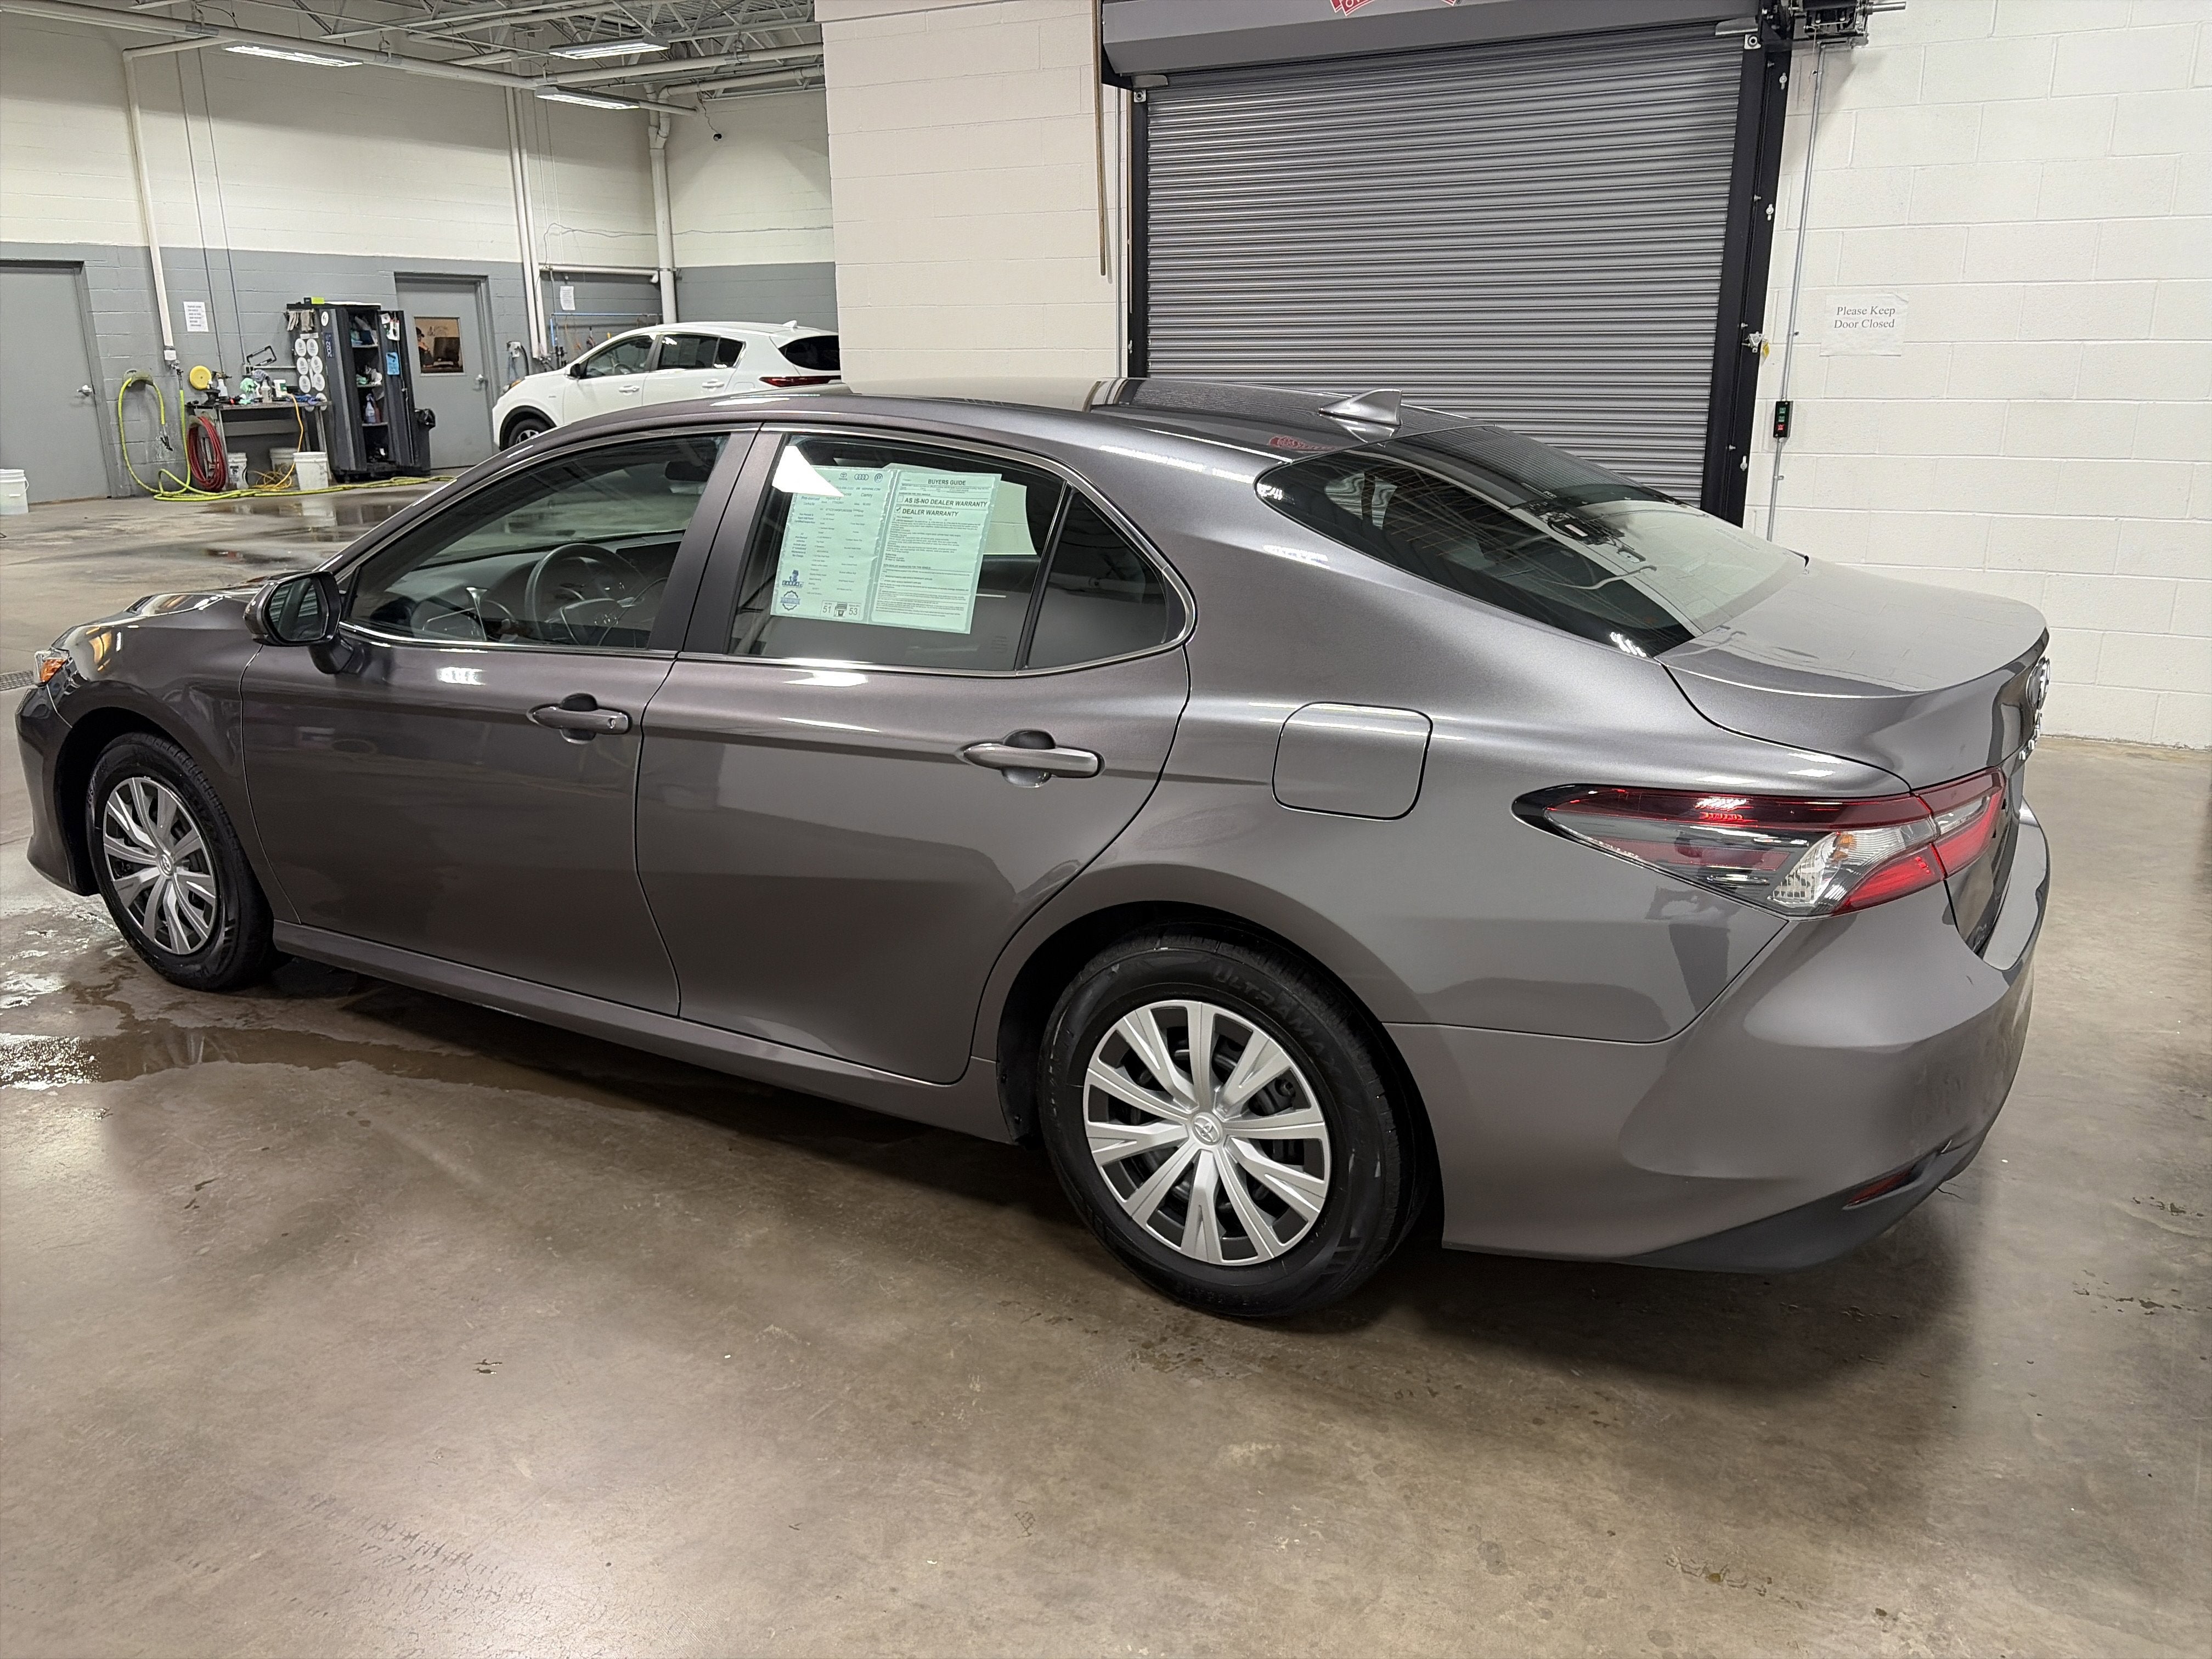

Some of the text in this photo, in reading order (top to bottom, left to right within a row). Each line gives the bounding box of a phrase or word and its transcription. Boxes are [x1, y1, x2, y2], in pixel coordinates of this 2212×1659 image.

[1836, 306, 1895, 317] Please Keep
[1834, 319, 1895, 328] Door Closed
[822, 605, 858, 616] 51 53
